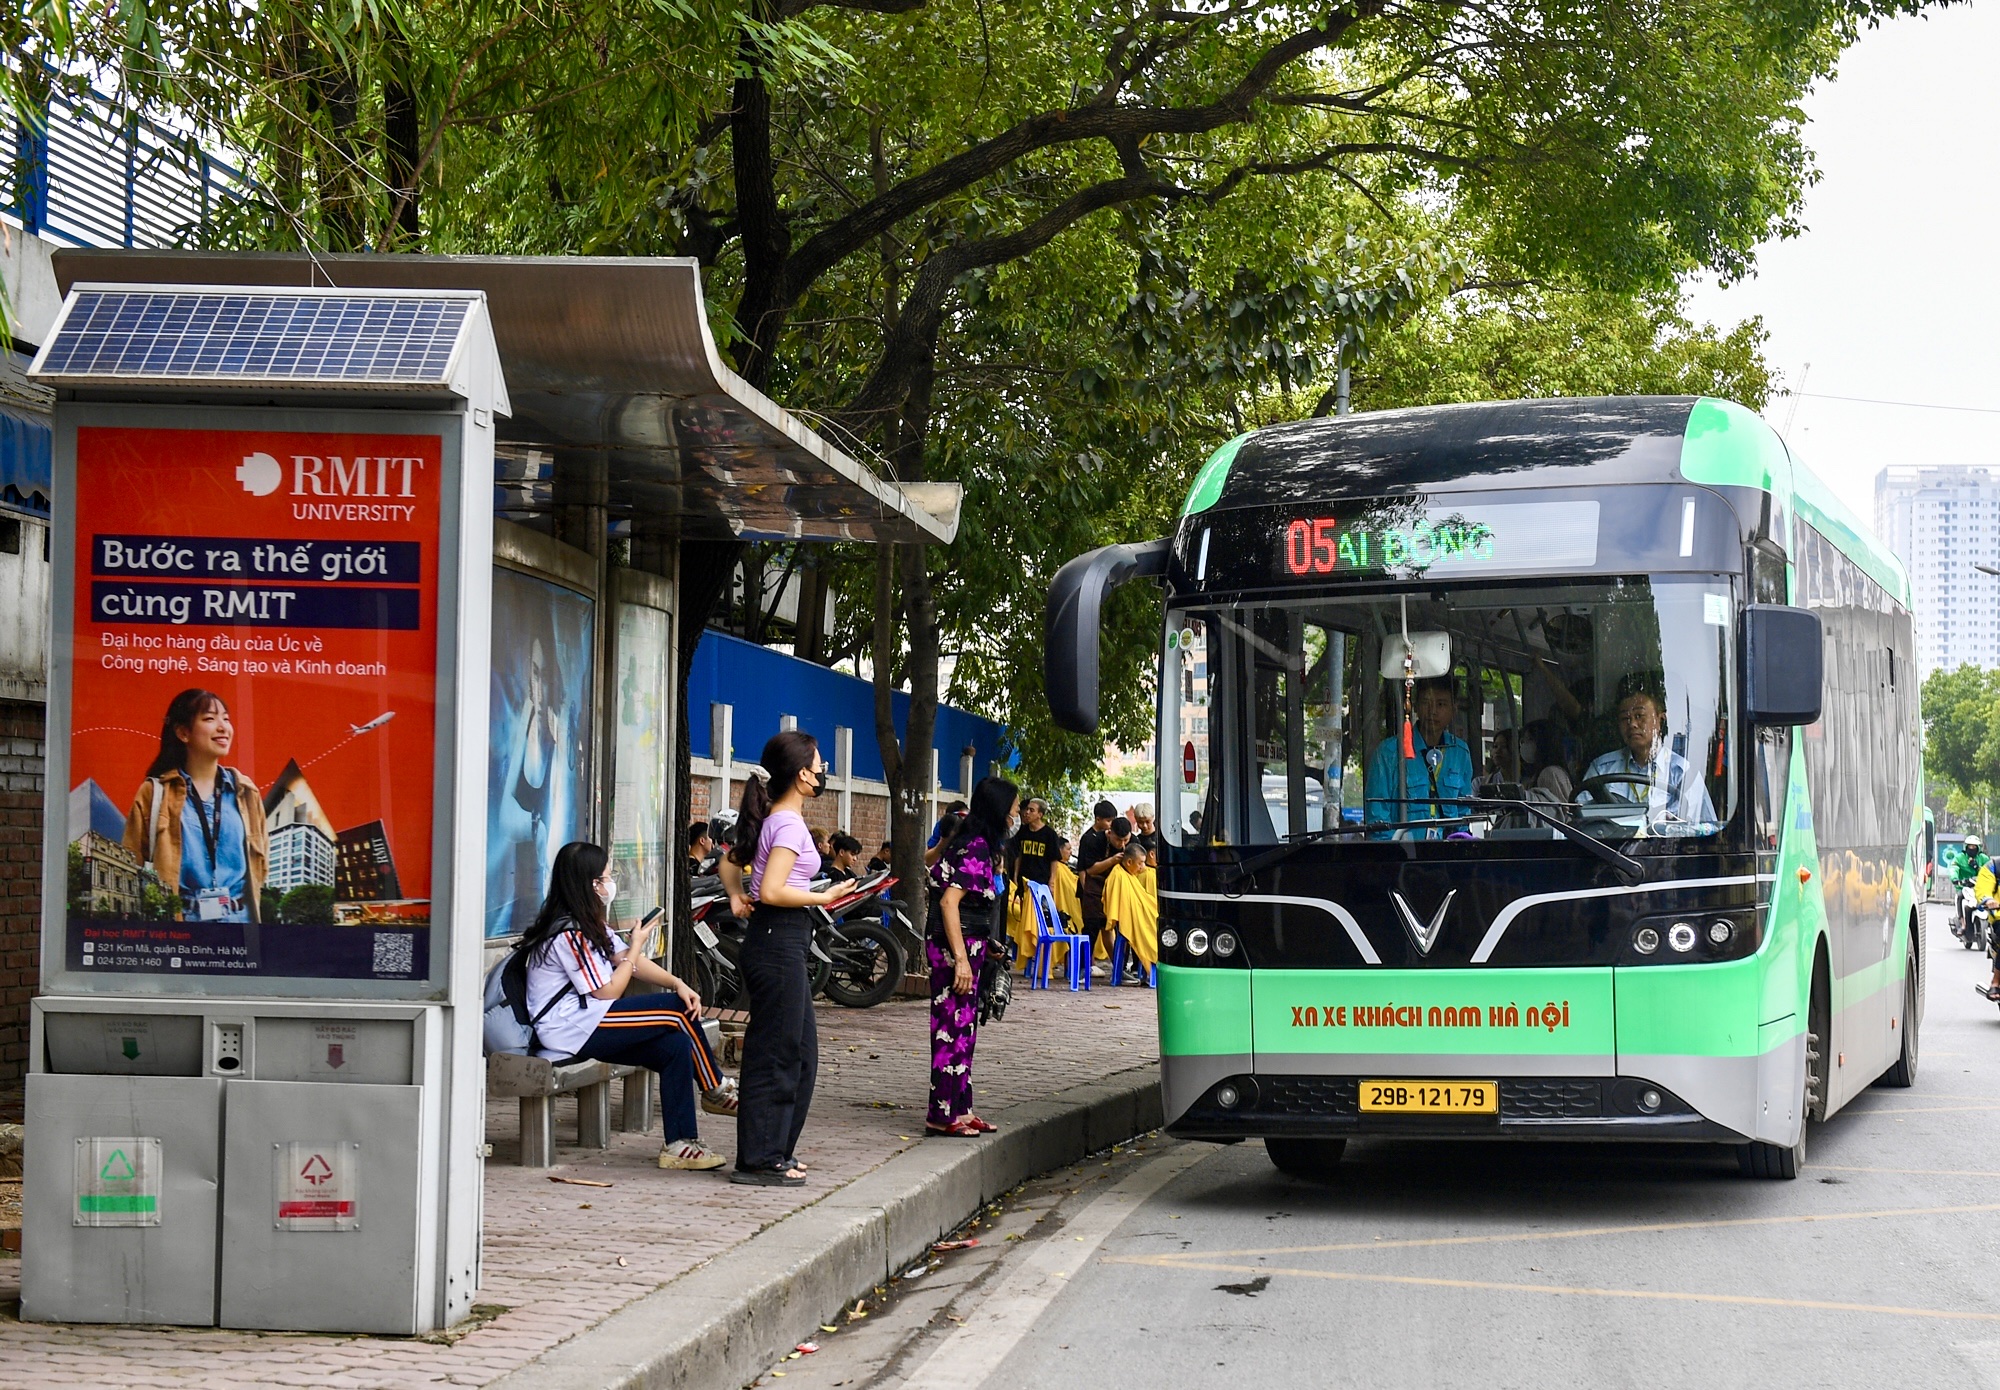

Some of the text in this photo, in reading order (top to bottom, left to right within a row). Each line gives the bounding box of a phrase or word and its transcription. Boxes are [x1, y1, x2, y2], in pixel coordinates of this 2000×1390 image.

[289, 455, 424, 498] RMIT
[292, 503, 416, 522] UNIVERSITY
[1287, 518, 1337, 574] 05
[102, 540, 388, 581] Bước ra thế giới
[101, 588, 296, 624] cùng RMIT
[101, 632, 323, 653] Đại học hàng đầu của Úc về
[101, 654, 387, 676] Công nghệ, Sáng tạo và Kinh doanh
[84, 929, 192, 940] Đại học RMIT Việt Nam
[97, 943, 114, 952] 521
[116, 944, 134, 952] Kim
[153, 945, 176, 955] quận
[178, 945, 190, 954] Ba
[217, 946, 230, 955] Hà
[232, 947, 248, 957] Nội
[97, 956, 257, 969] 024 3726 1460 www.rmit.edu.vn
[1291, 1000, 1570, 1033] XN XE KHÁCH NAM HÀ NỘI
[1371, 1088, 1485, 1107] 29B-121.79
